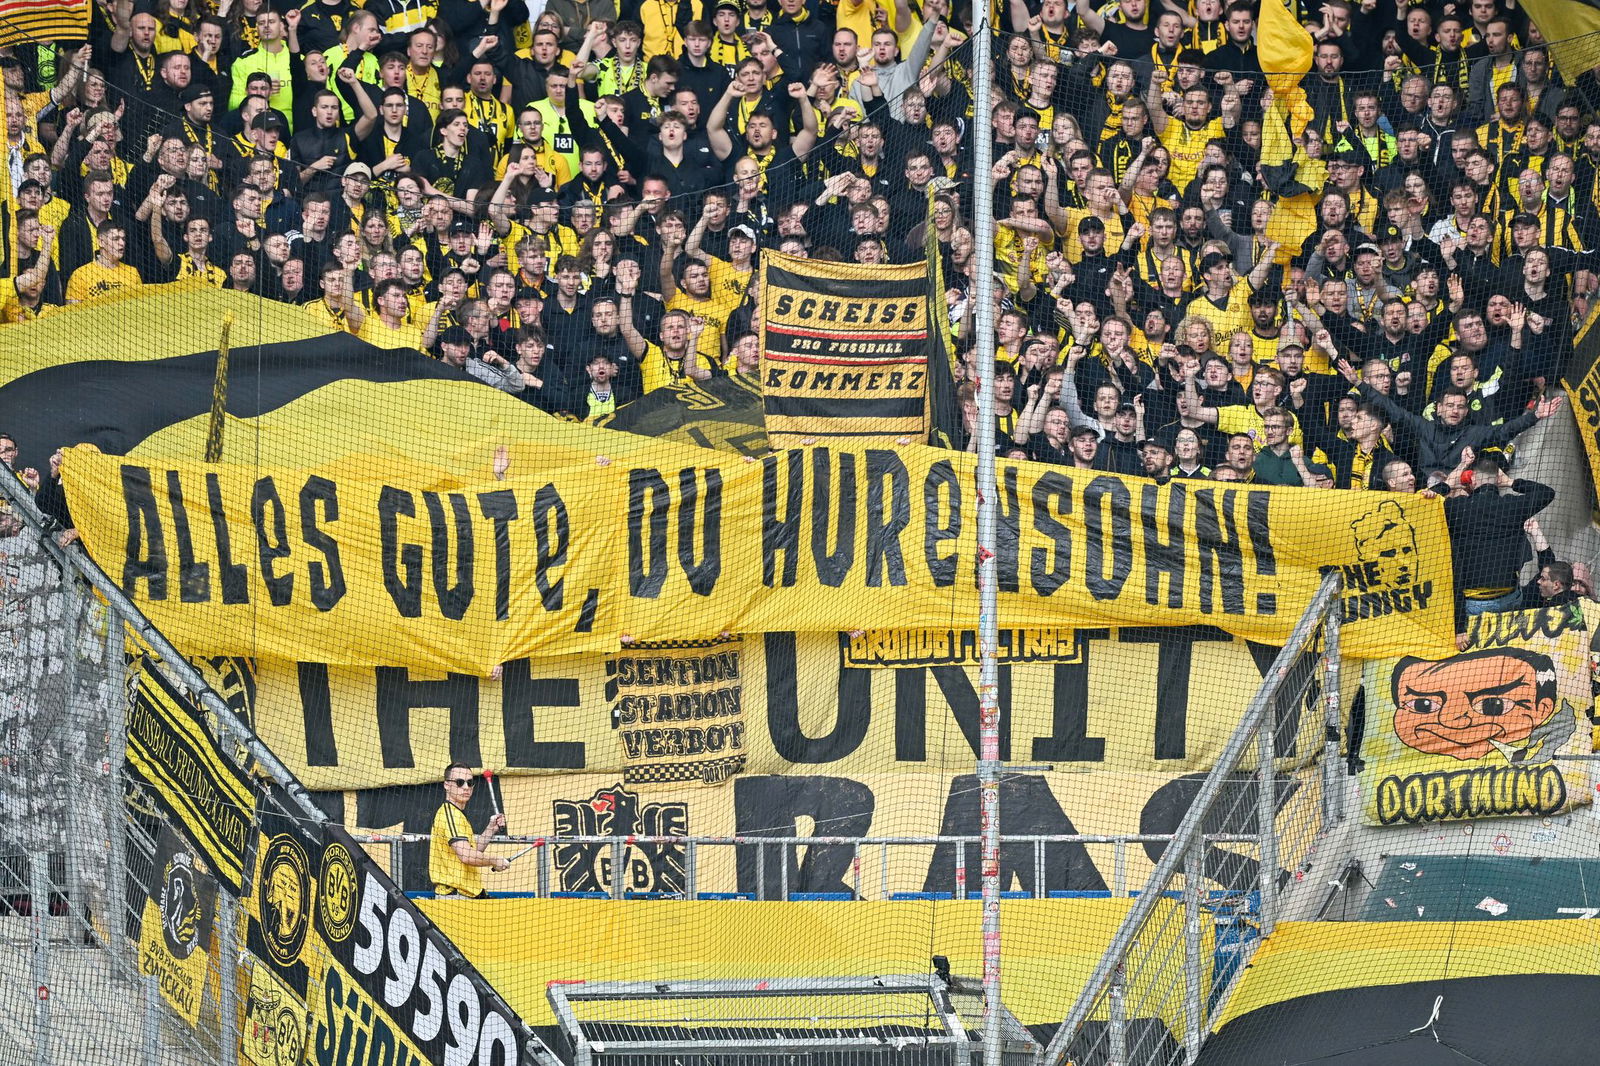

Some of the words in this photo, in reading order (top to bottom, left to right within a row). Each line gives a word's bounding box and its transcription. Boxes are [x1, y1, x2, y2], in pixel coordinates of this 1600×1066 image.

[555, 137, 572, 149] 1&1
[775, 294, 918, 324] SCHEISS
[791, 338, 821, 352] PRO
[828, 341, 903, 354] FUSSBALL
[765, 368, 925, 391] KOMMERZ
[627, 466, 723, 600] DU
[974, 628, 1076, 662] TRAS
[616, 651, 741, 687] SEKTION
[616, 686, 742, 724] STADION
[620, 721, 745, 759] VERBOT
[1376, 763, 1567, 825] DORTMUND
[210, 798, 248, 854] KAMEN
[325, 846, 356, 893] BORUSSIA
[328, 867, 349, 912] BVB
[150, 940, 164, 962] BVB
[142, 951, 195, 1015] ZWICKAU
